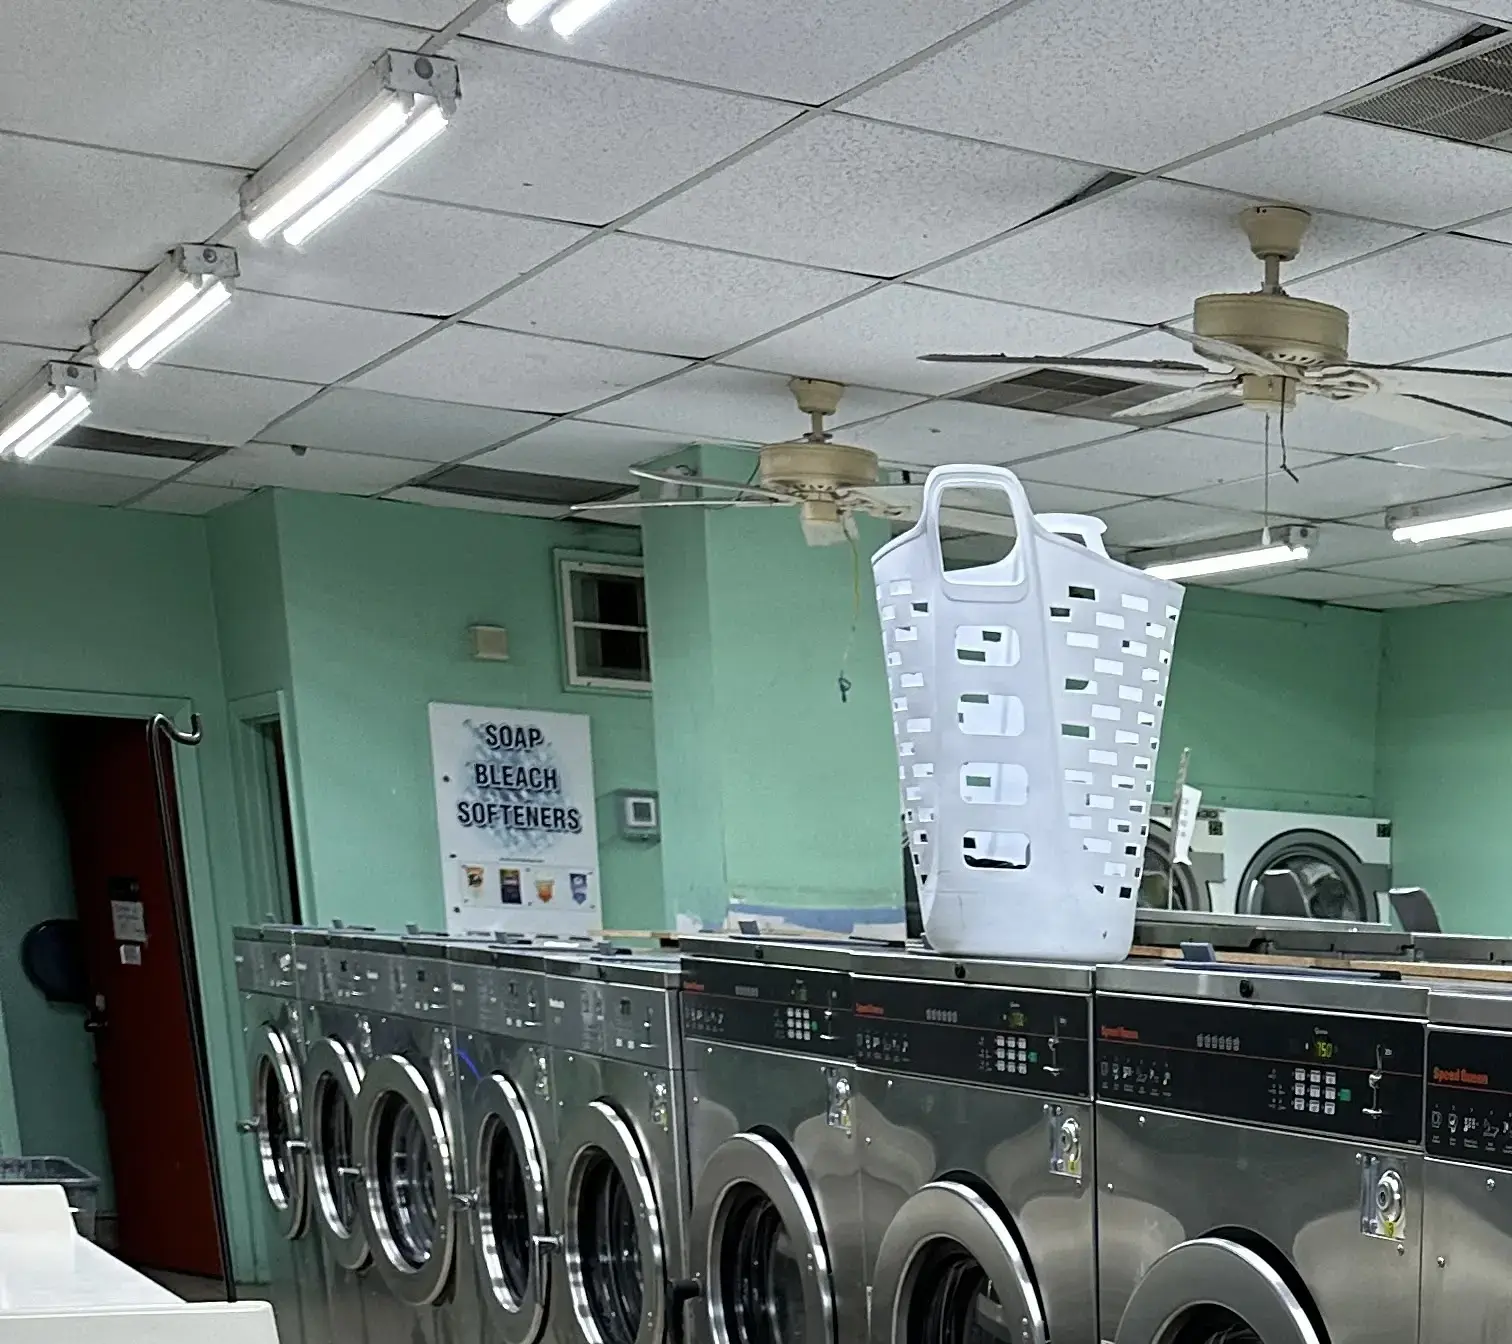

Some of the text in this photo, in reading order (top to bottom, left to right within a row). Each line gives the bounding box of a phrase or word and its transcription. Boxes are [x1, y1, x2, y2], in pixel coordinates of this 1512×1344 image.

[485, 723, 543, 749] SOAP
[474, 763, 558, 791] BLEACH
[457, 801, 582, 832] SOFTENERS
